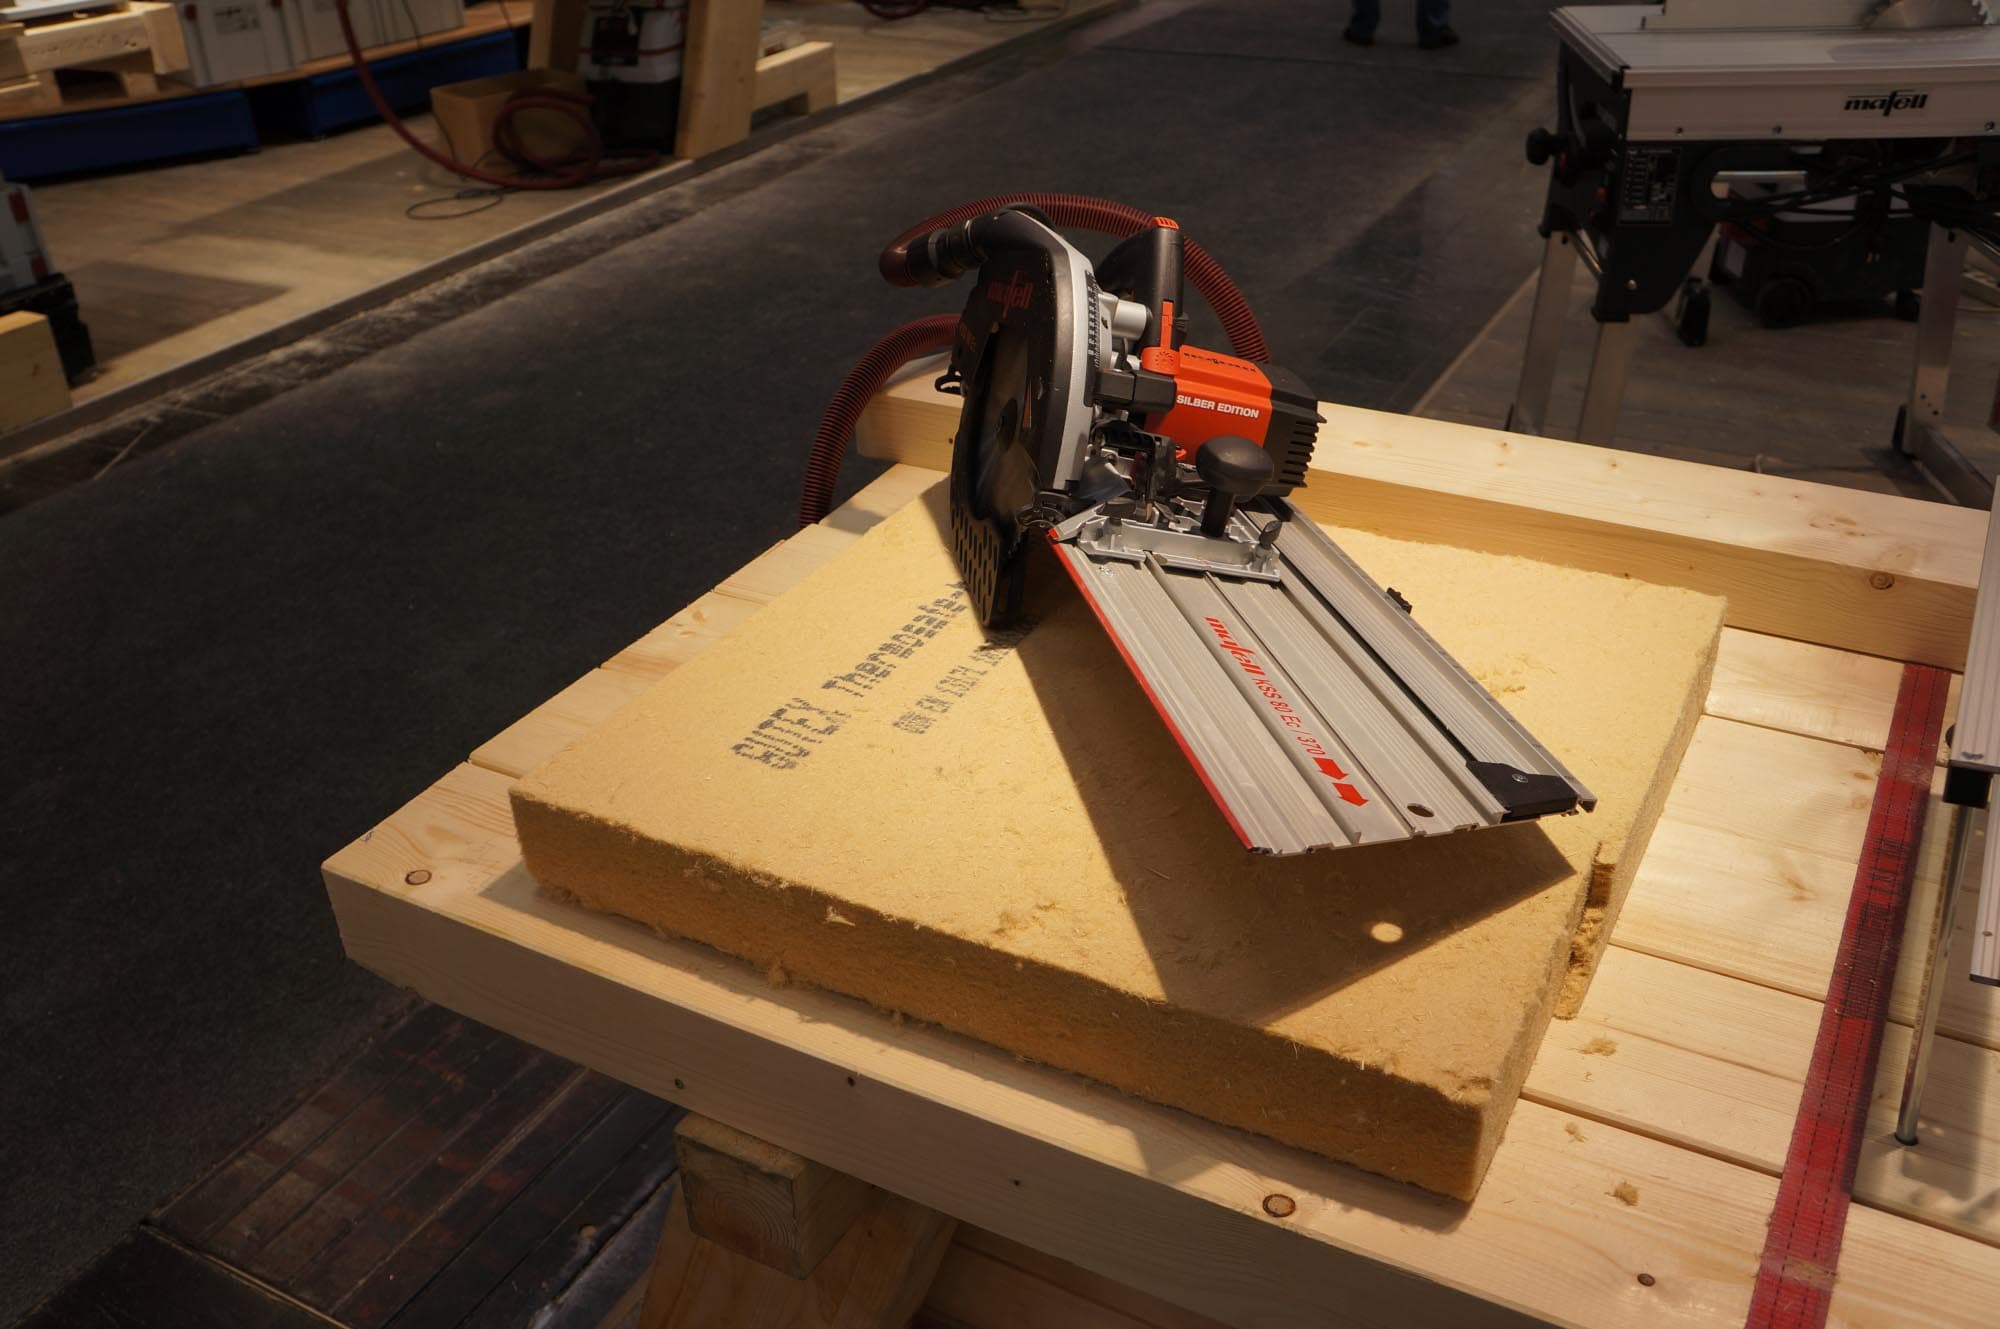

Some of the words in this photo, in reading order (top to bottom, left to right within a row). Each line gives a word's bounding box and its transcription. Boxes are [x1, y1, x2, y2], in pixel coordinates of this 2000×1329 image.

[1843, 89, 1928, 117] mafell
[1176, 394, 1216, 410] SILBER
[1217, 402, 1260, 419] EDITION
[1204, 616, 1266, 676] mafell
[1252, 678, 1283, 700] KSS
[1270, 700, 1293, 714] 80
[1297, 736, 1326, 756] 370
[731, 697, 851, 770] GUTEX
